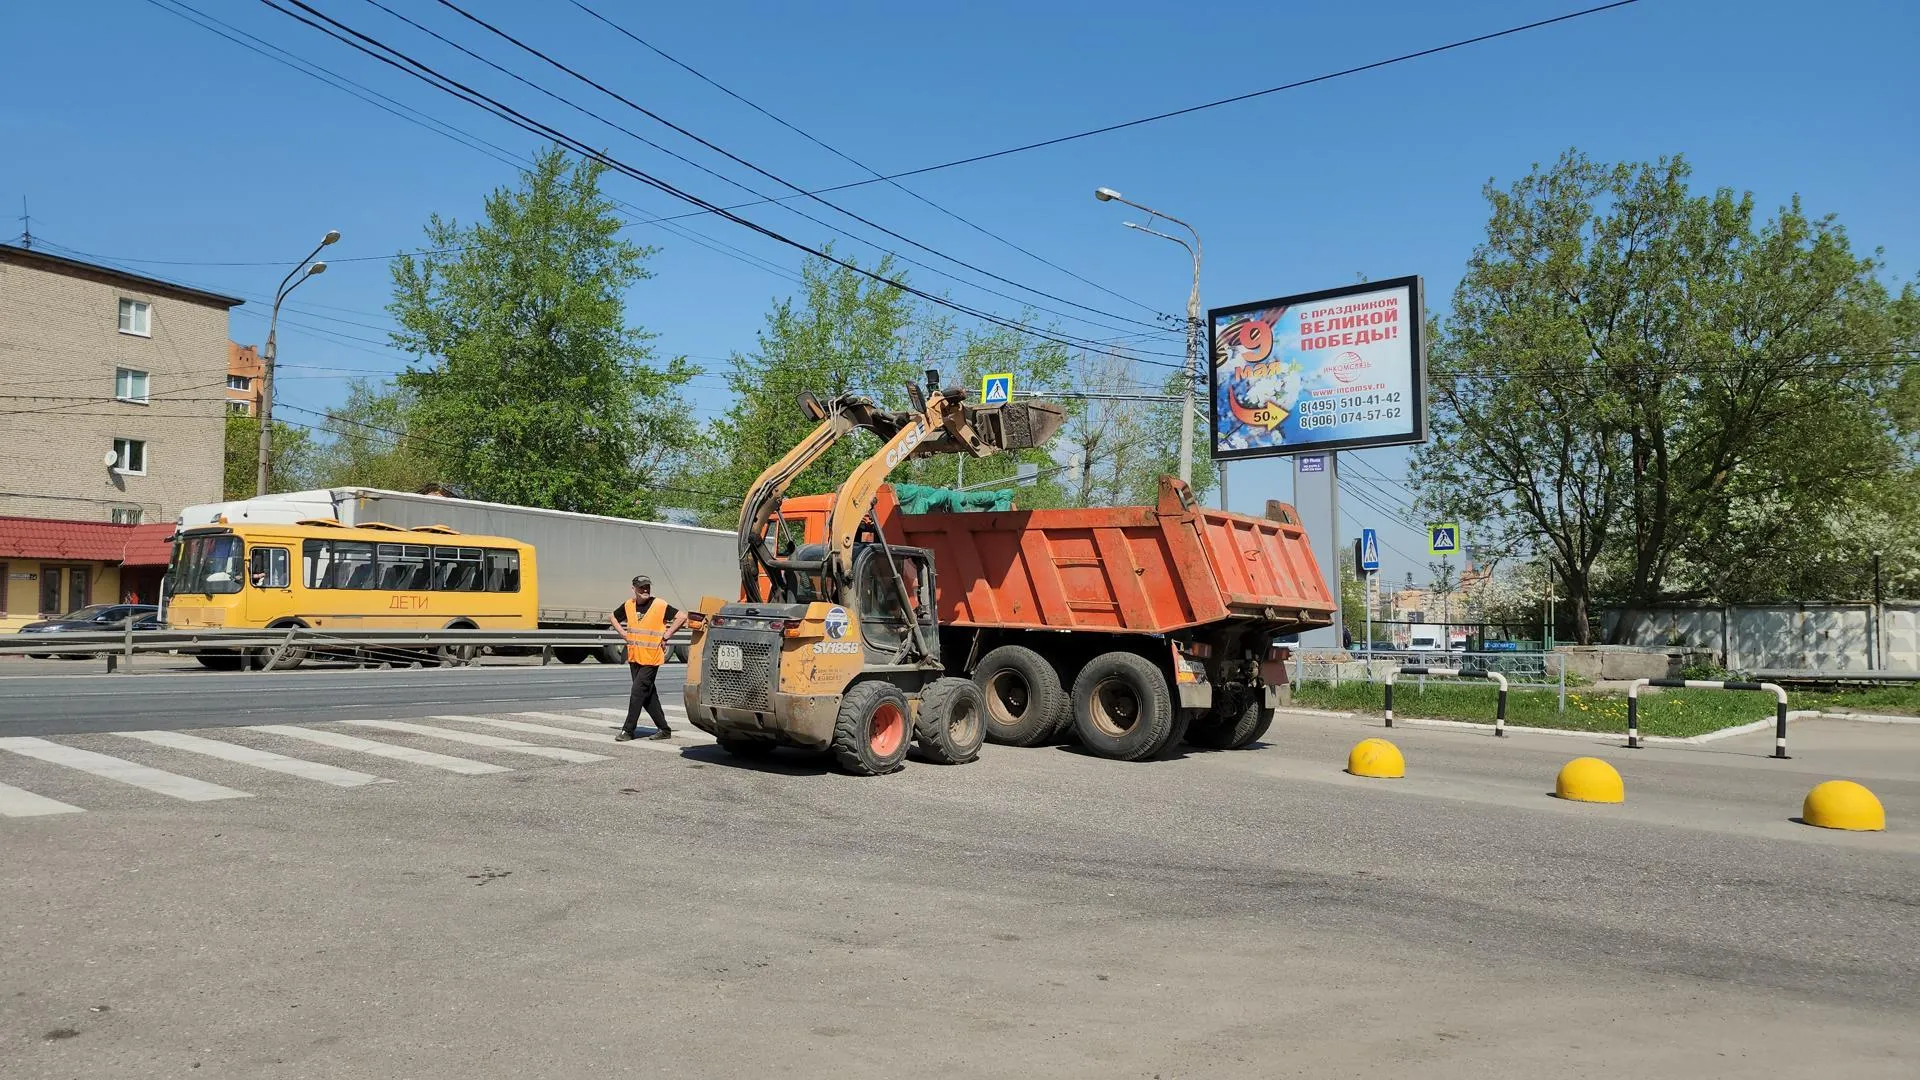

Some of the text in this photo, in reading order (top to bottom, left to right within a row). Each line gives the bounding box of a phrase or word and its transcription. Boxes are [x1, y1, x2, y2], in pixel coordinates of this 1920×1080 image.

[1300, 298, 1398, 320] С ПРАЗДНИКОМ
[1300, 307, 1398, 335] ВЕЛИКОЙ
[1240, 320, 1273, 363] 9
[1300, 326, 1398, 352] ПОБЕДЫ!
[1312, 383, 1385, 397] www.incomsv.ru
[1300, 391, 1401, 414] 8(495) 510-41-42
[1300, 407, 1401, 428] 8(906) 074-57-62
[886, 421, 927, 467] CASE
[389, 596, 429, 609] ДЕТИ
[721, 647, 739, 658] 6351
